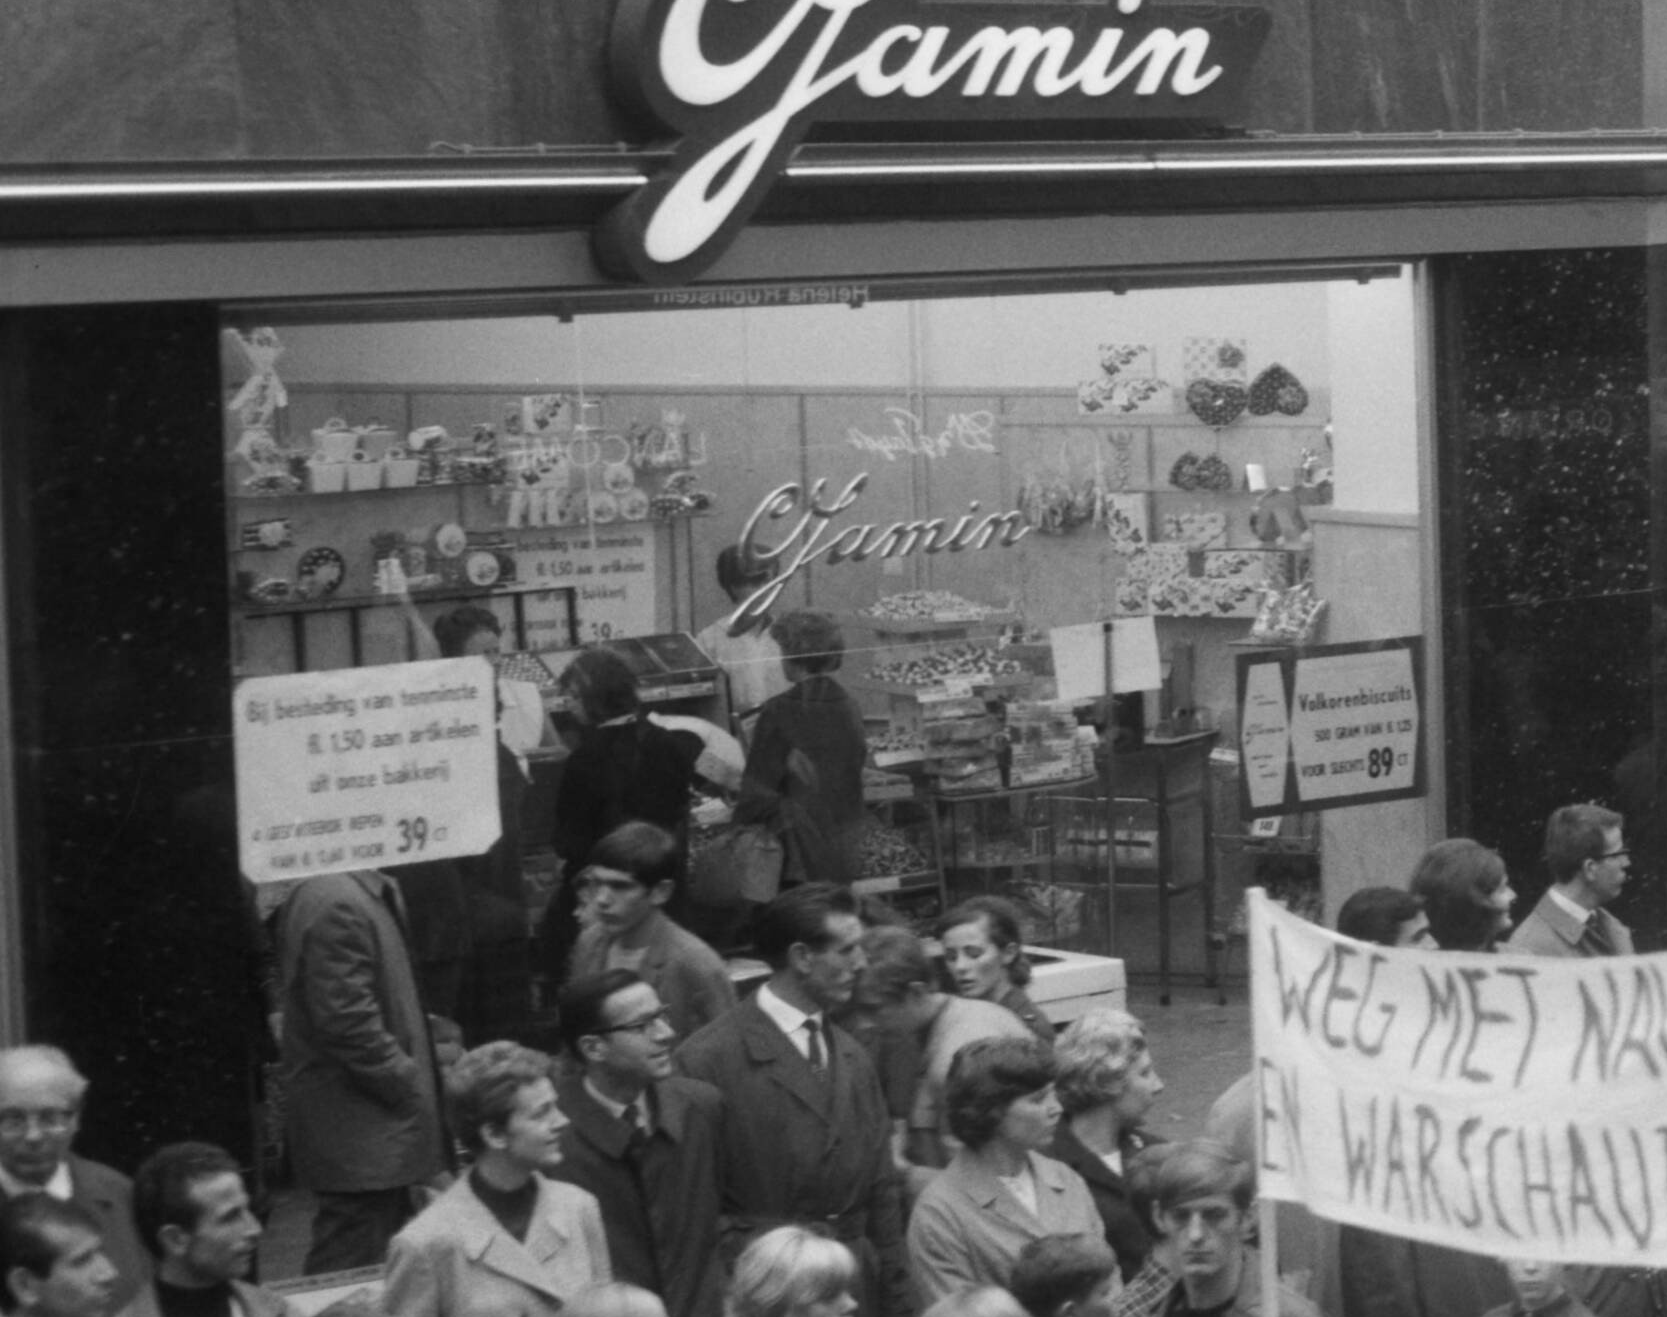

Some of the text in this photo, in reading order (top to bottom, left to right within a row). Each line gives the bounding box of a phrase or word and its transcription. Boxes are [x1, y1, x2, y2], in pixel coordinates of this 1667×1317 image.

[1298, 685, 1413, 713] Volkorenbiscuits
[1366, 745, 1395, 780] 89
[394, 814, 430, 855] 39
[1269, 923, 1399, 1058] WEG
[1411, 963, 1540, 1089] MET
